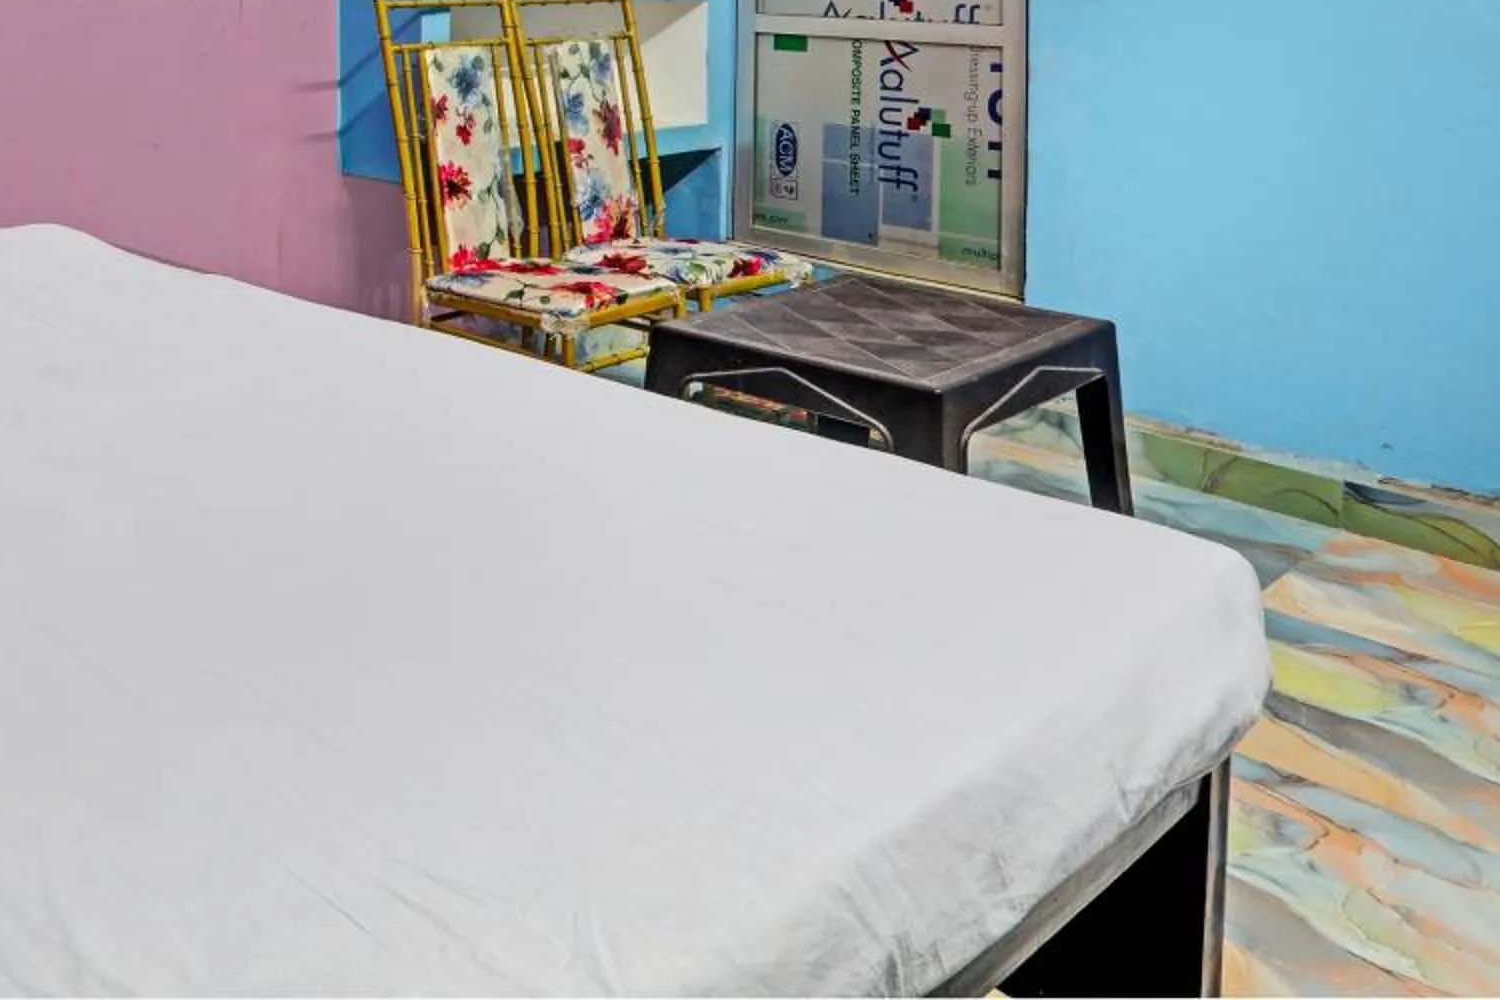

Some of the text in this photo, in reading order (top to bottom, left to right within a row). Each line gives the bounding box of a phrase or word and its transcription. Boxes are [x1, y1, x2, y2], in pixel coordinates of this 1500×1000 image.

[849, 109, 862, 149] PANEL
[878, 40, 920, 192] Aalutuff
[778, 126, 795, 173] ACM
[849, 153, 861, 195] SHEET
